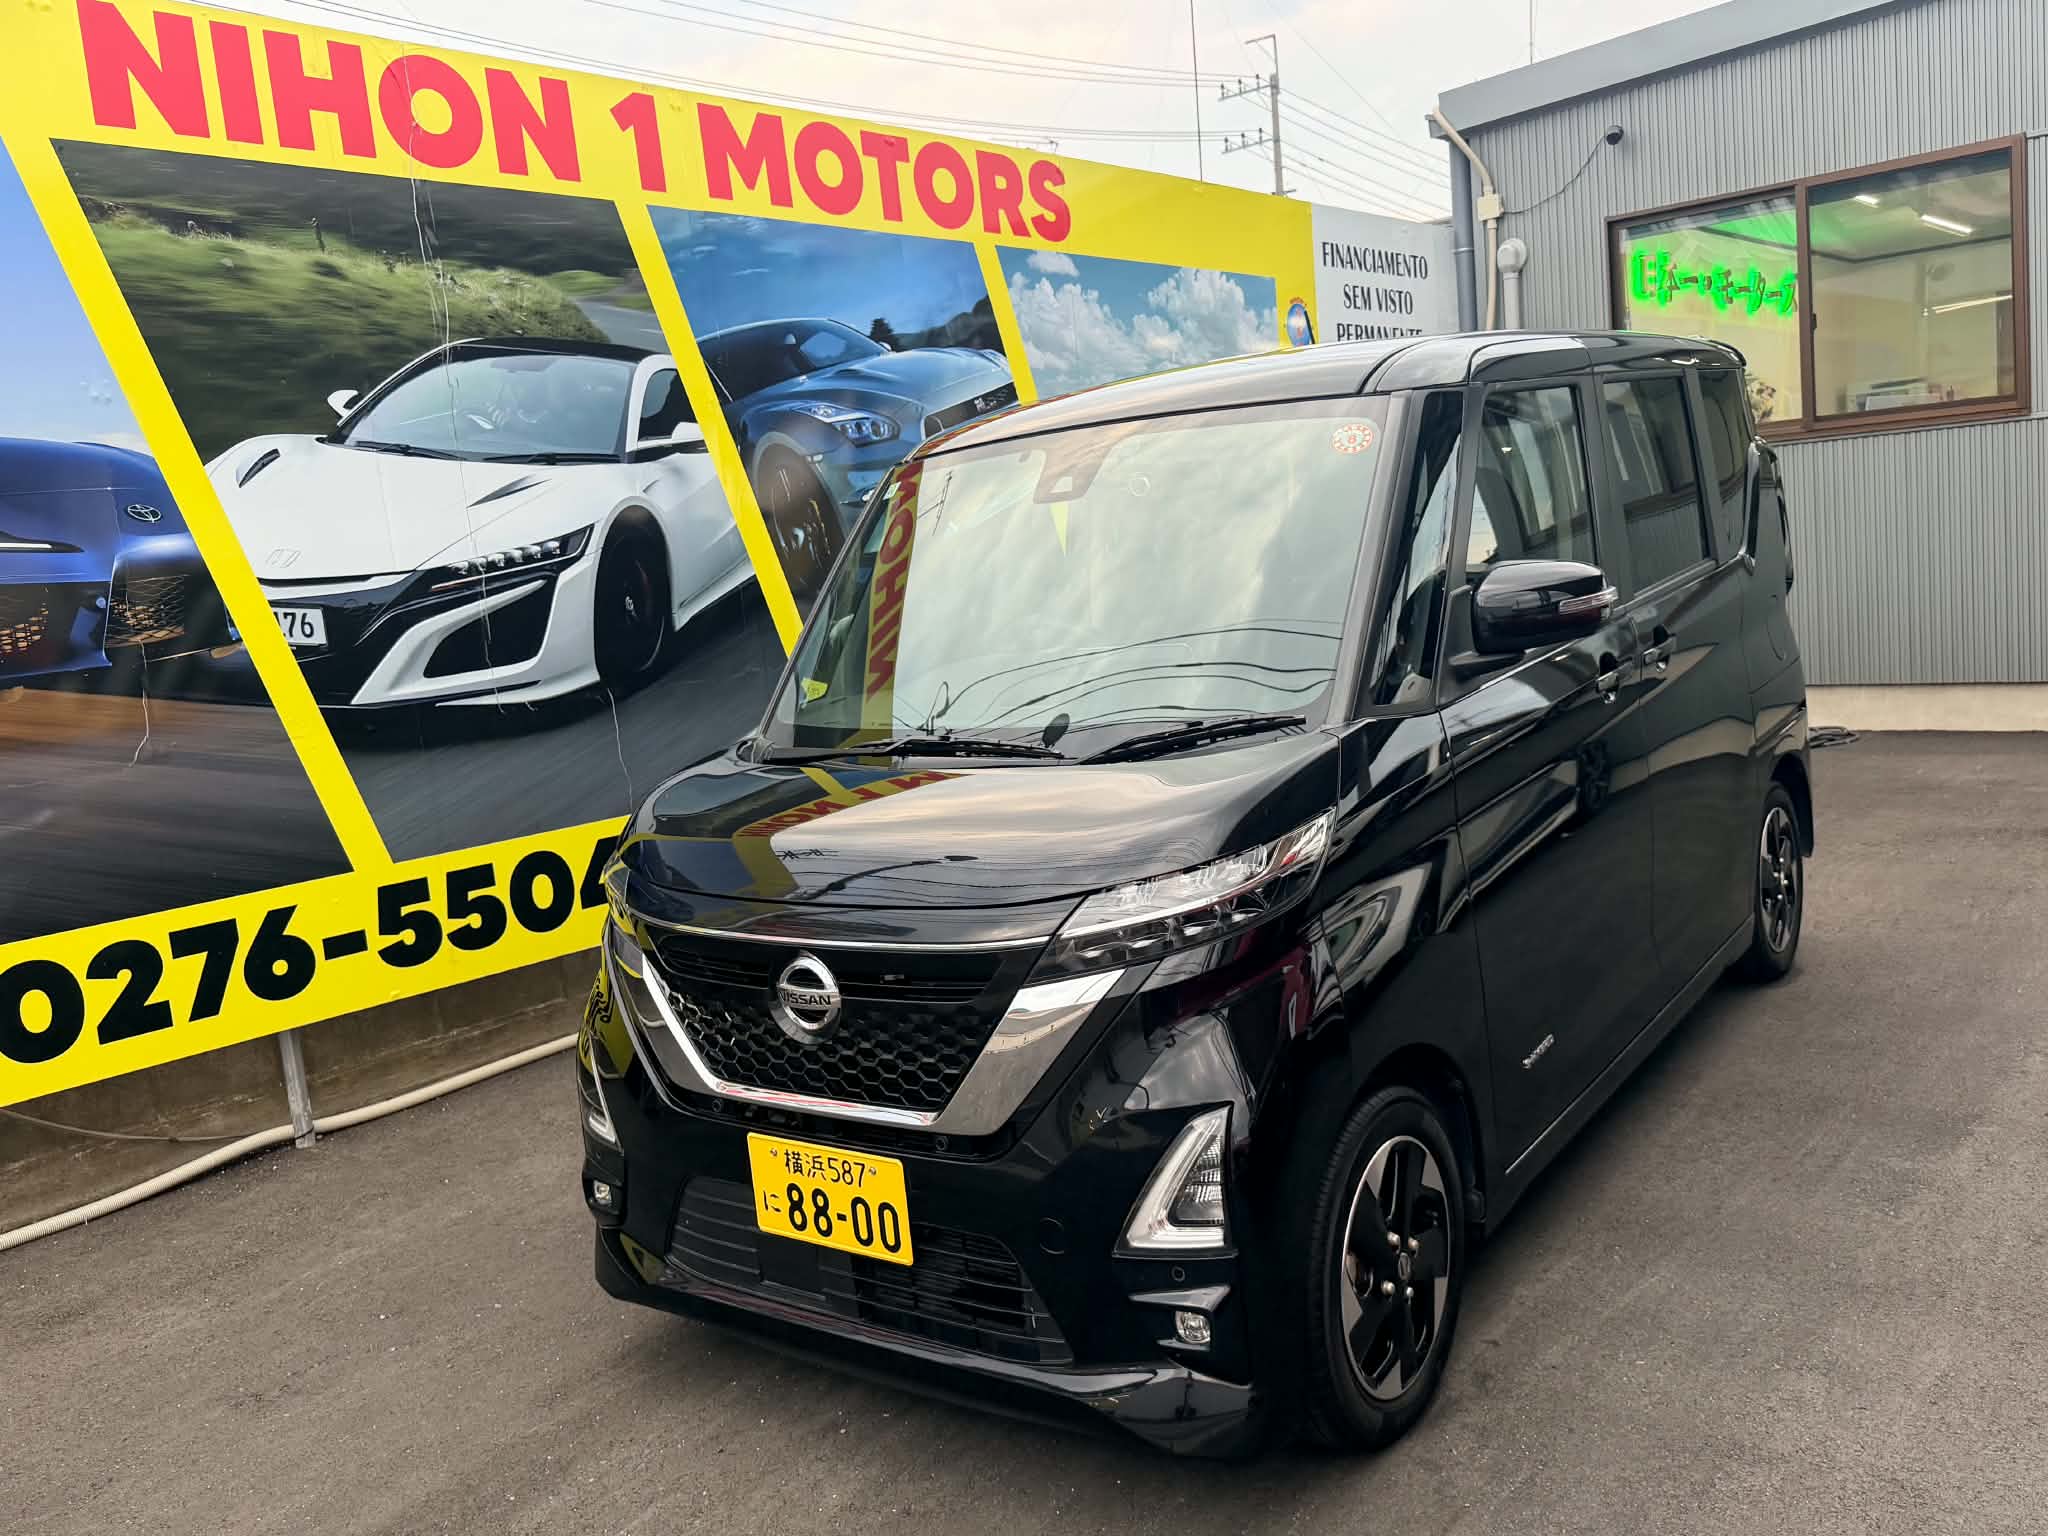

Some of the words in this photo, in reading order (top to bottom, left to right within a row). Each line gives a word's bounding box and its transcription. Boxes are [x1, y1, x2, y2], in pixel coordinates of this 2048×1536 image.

[76, 0, 581, 183] NIHON
[609, 92, 667, 193] 1
[696, 101, 1072, 243] MOTORS
[1321, 241, 1429, 280] FINANCIAMENTO
[1343, 283, 1372, 312] SEM
[1375, 287, 1414, 315] VISTO
[273, 611, 315, 638] 76
[781, 990, 832, 1006] NISSAN
[763, 1190, 781, 1213] に
[786, 1182, 902, 1254] 88-00
